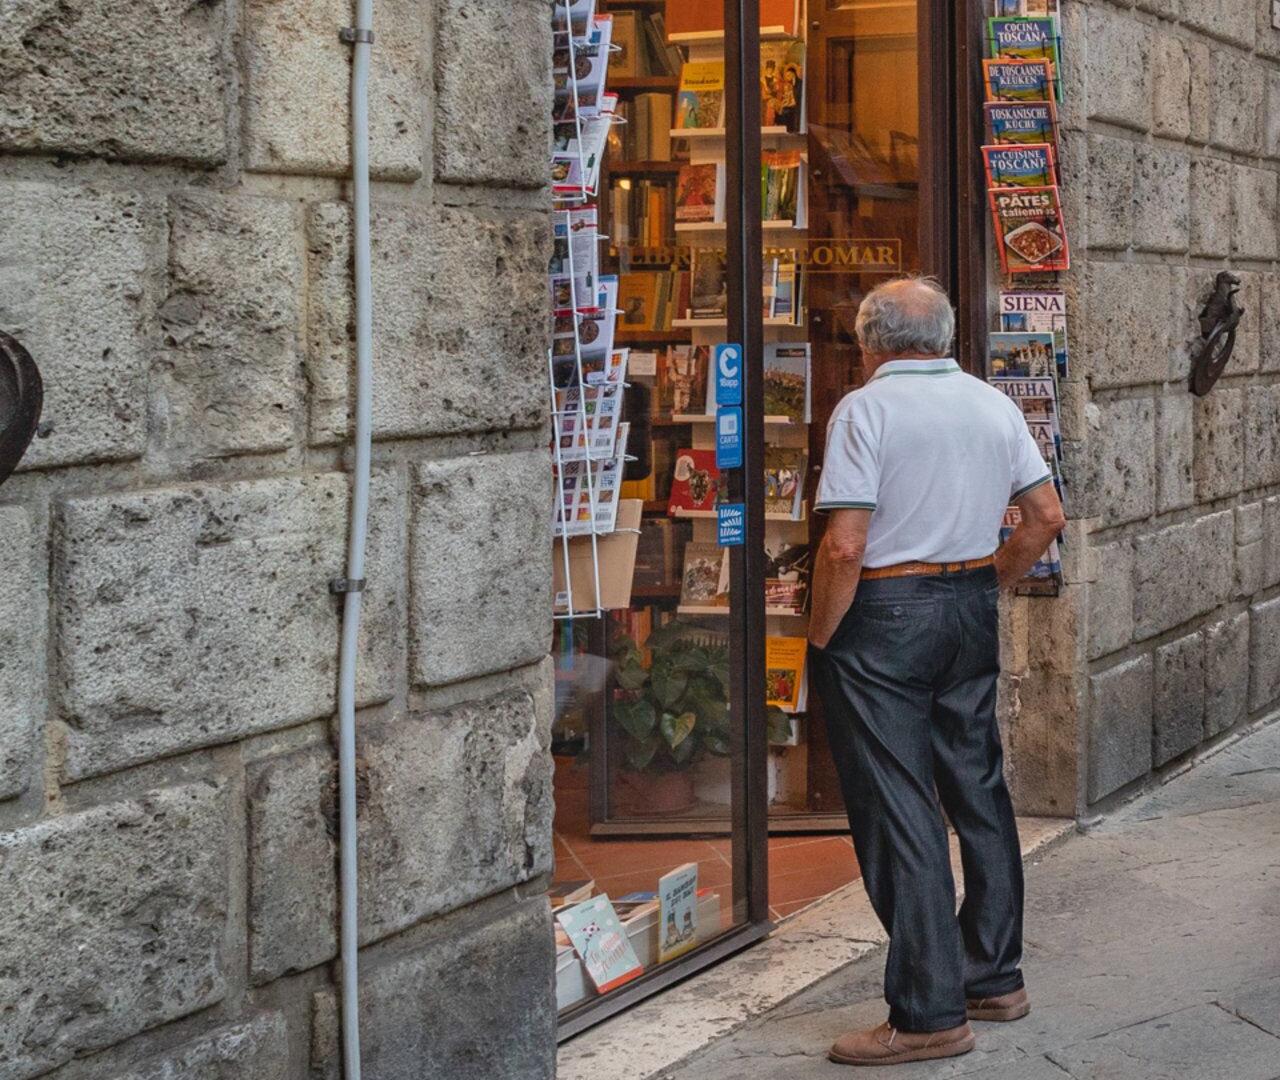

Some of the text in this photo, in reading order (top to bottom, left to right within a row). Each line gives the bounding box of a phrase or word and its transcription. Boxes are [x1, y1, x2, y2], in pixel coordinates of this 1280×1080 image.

[1004, 23, 1040, 32] COCINA
[998, 31, 1048, 42] TOSCANA
[990, 66, 1046, 76] DE TOSCAANSE
[990, 108, 1048, 120] TOSKANISCHE
[1001, 150, 1041, 160] CUISINE
[999, 193, 1050, 208] PÂTES
[1004, 297, 1061, 311] SIENA
